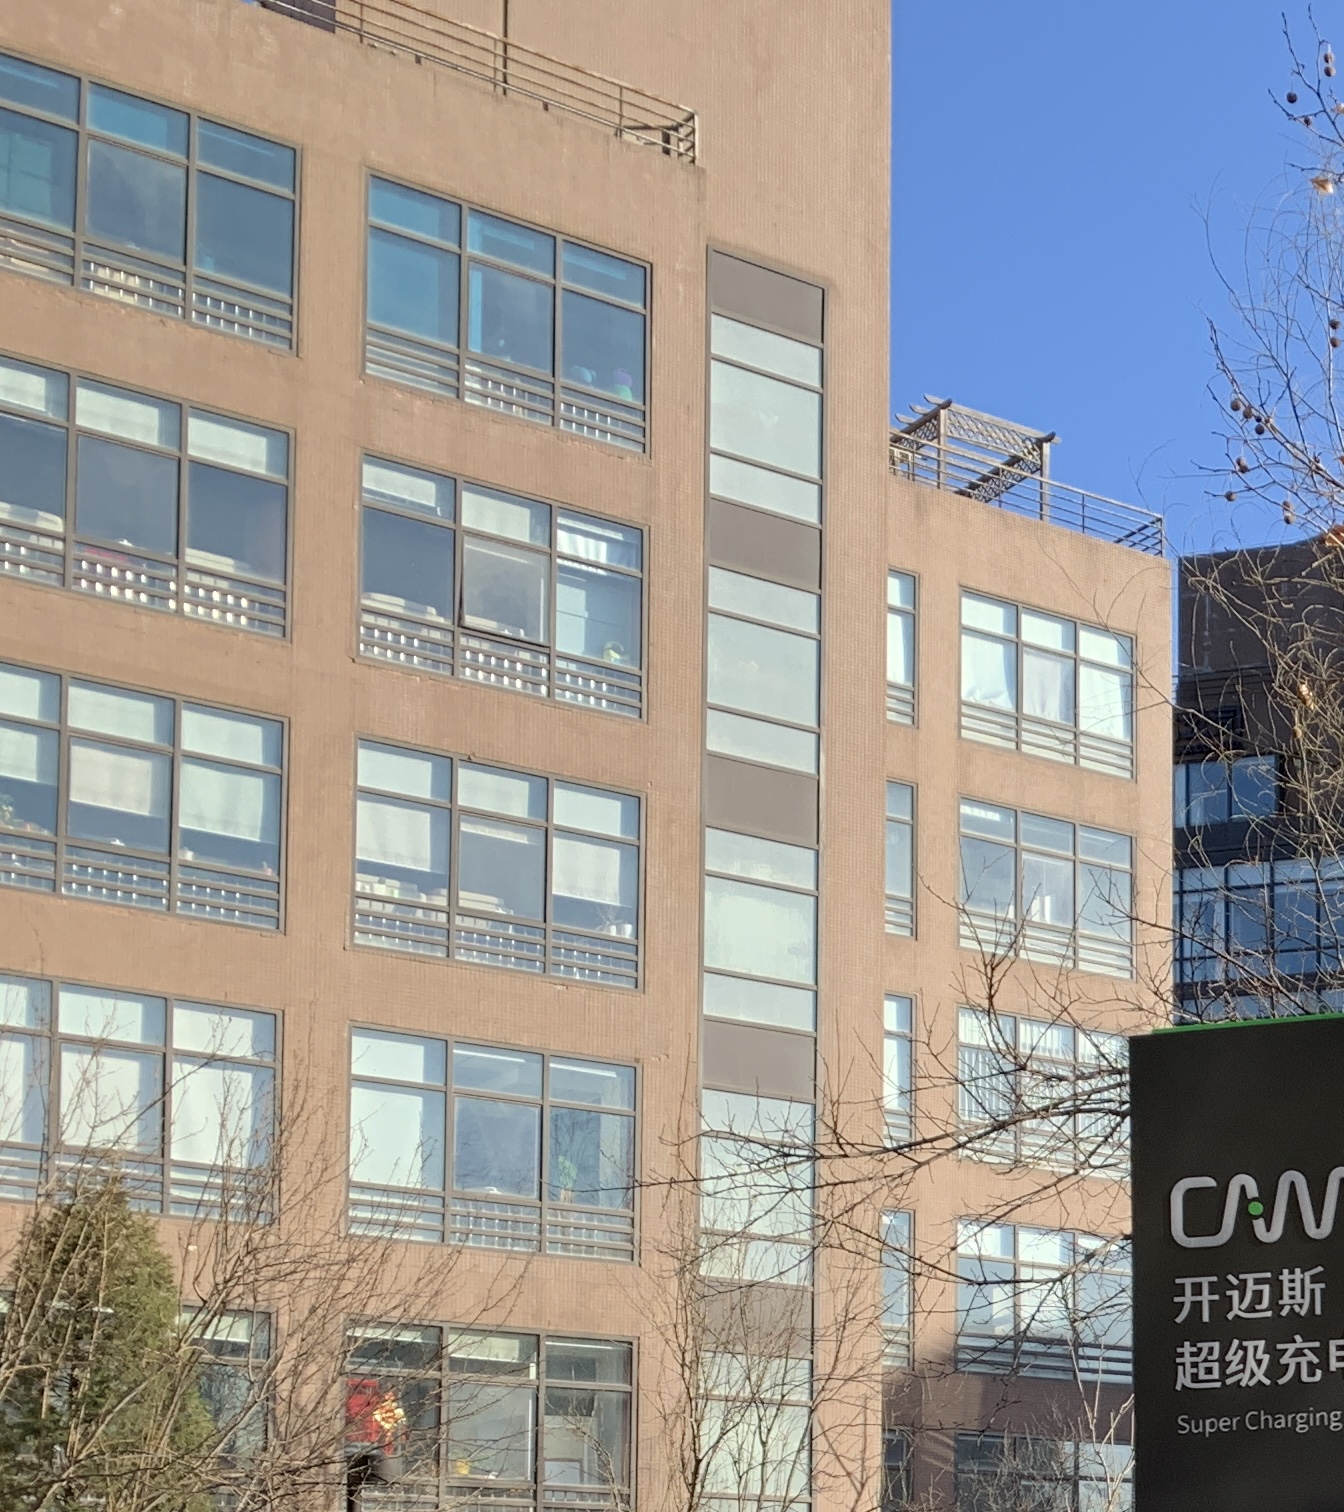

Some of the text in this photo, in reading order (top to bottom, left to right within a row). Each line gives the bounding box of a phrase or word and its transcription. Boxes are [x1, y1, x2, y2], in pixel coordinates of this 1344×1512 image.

[1173, 1265, 1326, 1324] 开迈斯
[1177, 1414, 1240, 1437] Super
[1245, 1407, 1343, 1433] Charging
